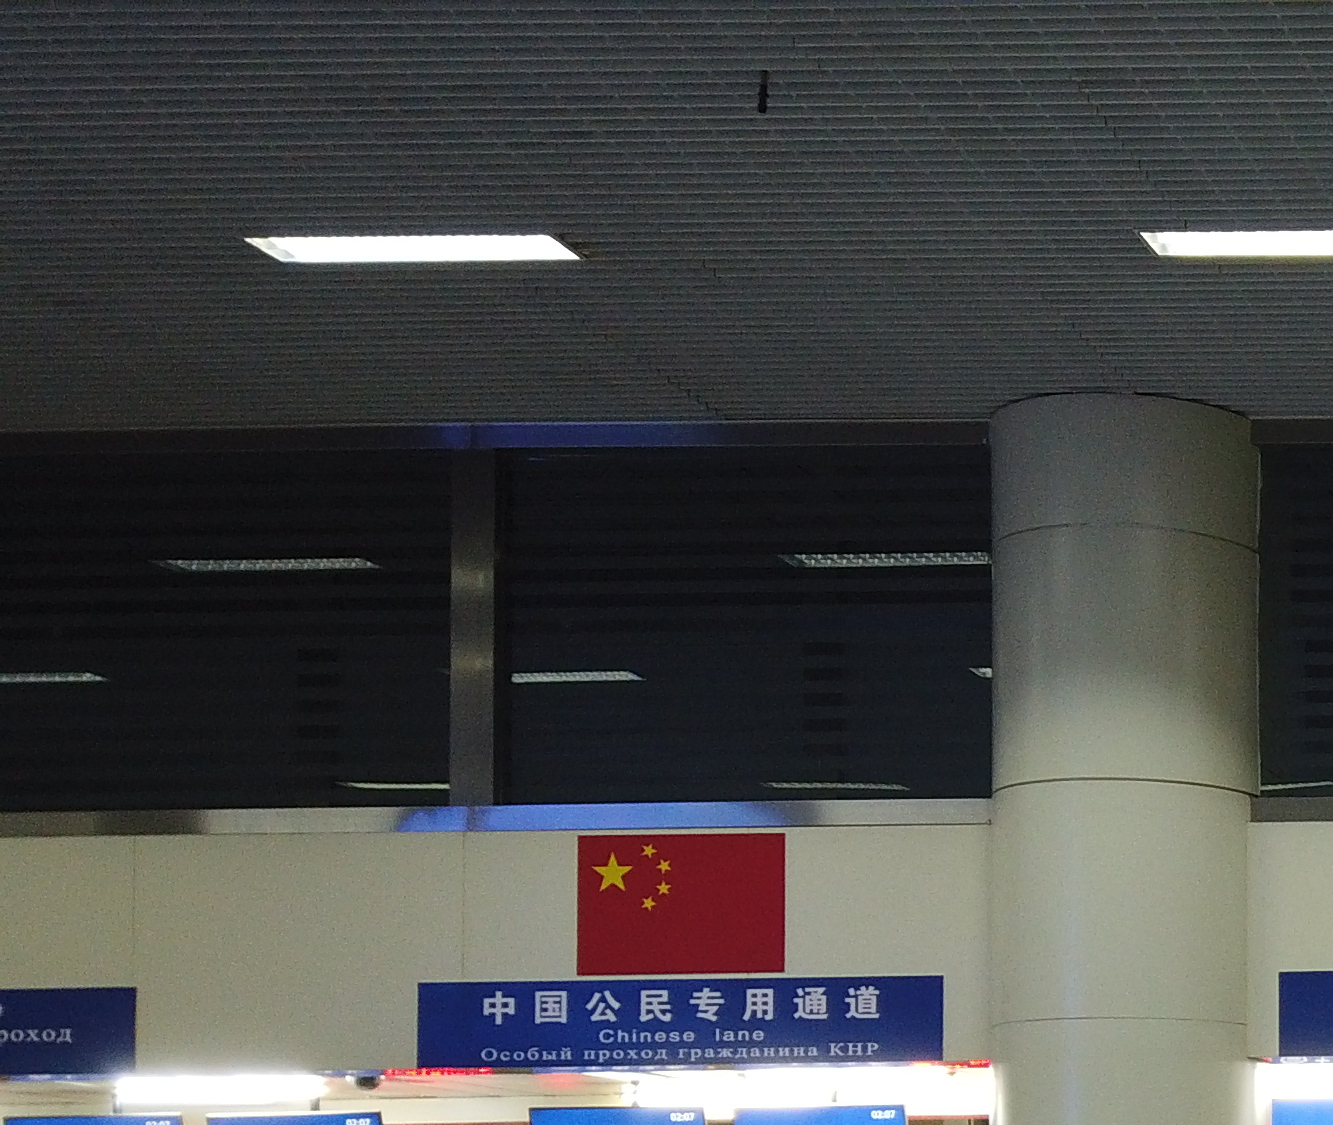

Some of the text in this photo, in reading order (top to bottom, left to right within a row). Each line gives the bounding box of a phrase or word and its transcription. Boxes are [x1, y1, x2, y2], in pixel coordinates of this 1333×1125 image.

[482, 985, 881, 1025] 中国公民专用通道
[598, 1027, 765, 1044] Chinese lane
[480, 1042, 880, 1064] Особый проход гражданина КНР
